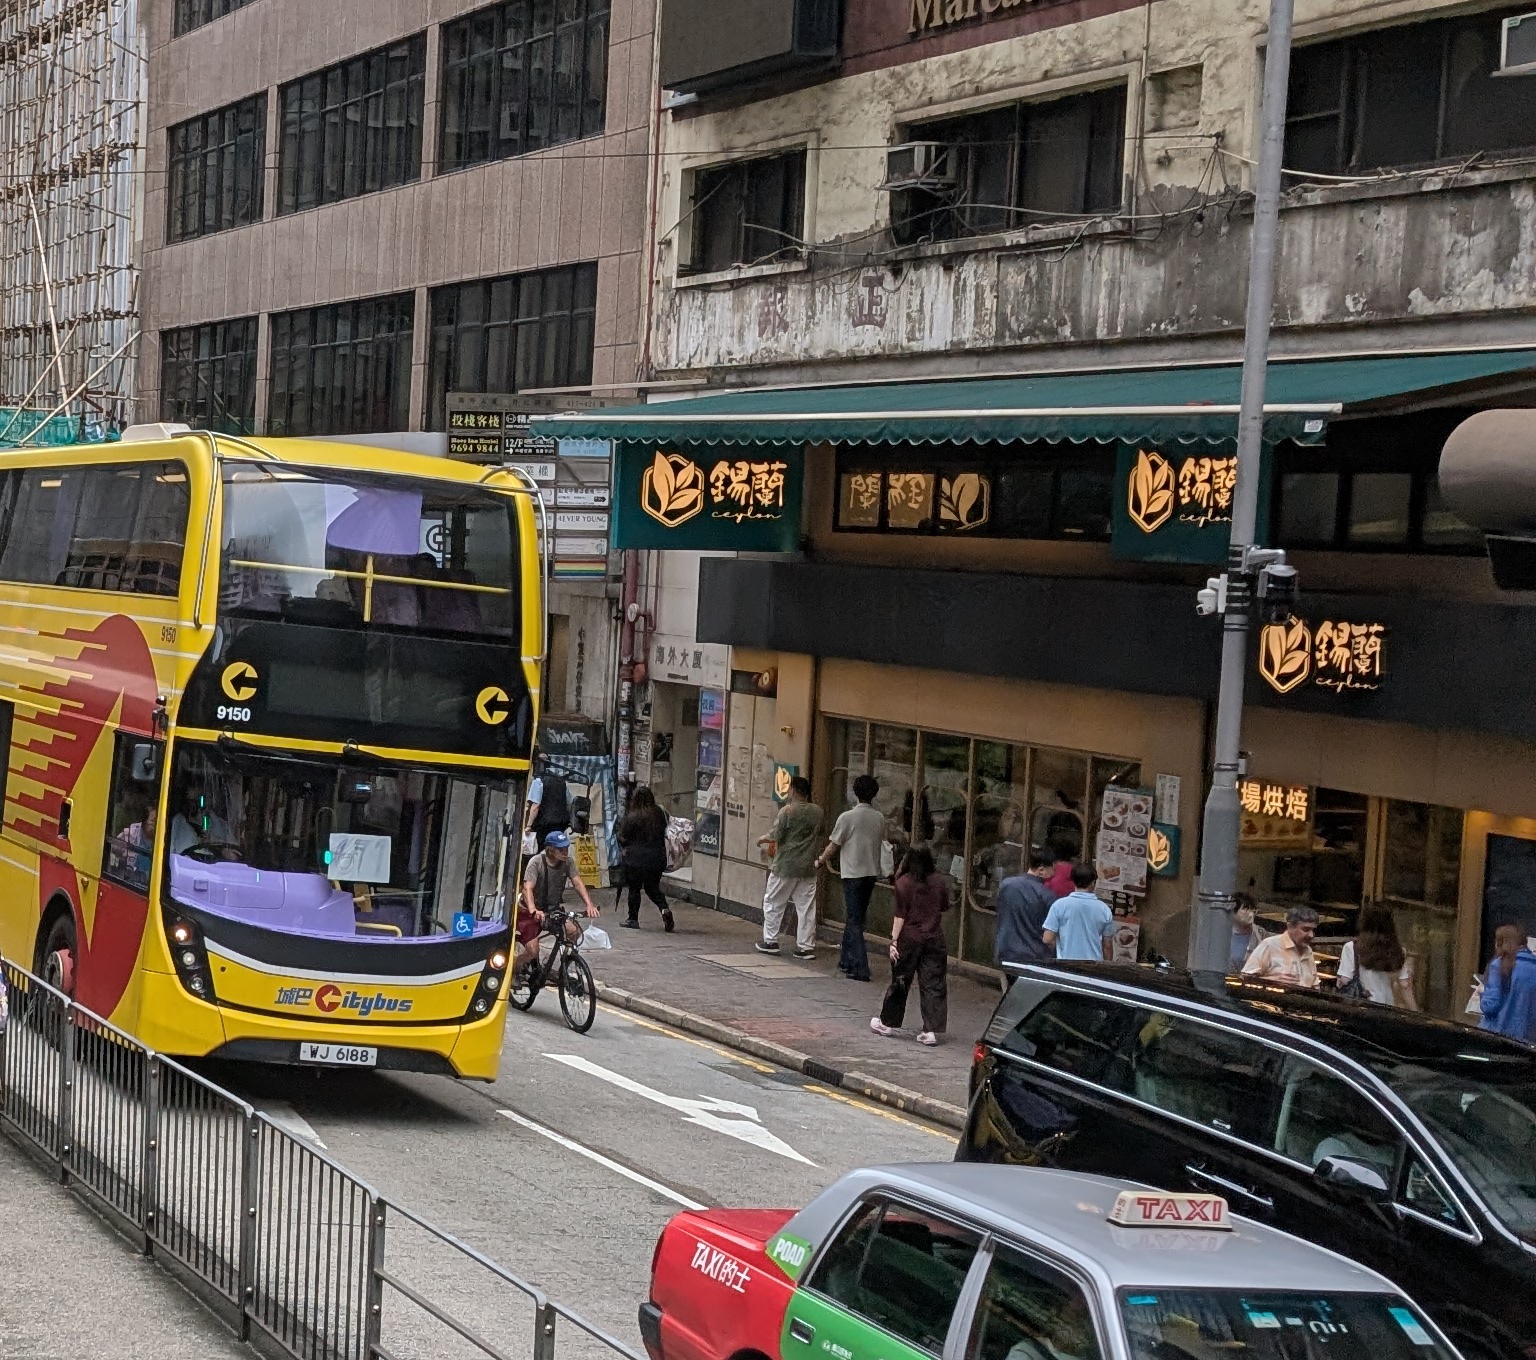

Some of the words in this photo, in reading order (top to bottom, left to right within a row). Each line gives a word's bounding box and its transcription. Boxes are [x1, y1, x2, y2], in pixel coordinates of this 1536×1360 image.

[450, 443, 473, 453] 9694
[476, 443, 499, 453] 9844
[505, 438, 523, 448] 12/F
[709, 460, 787, 507] 錫蘭
[582, 515, 607, 523] YOUNG
[711, 506, 782, 524] ceylon
[1179, 508, 1234, 528] ceylon
[1314, 620, 1385, 677] 錫蘭
[1315, 674, 1379, 693] ceylon
[216, 705, 252, 722] 9150
[1235, 779, 1309, 822] 場烘焙
[314, 983, 414, 1017] Citybus
[309, 1044, 330, 1060] WJ
[335, 1047, 369, 1063] 6188
[1135, 1197, 1223, 1223] TAXI
[772, 1237, 806, 1267] POAD
